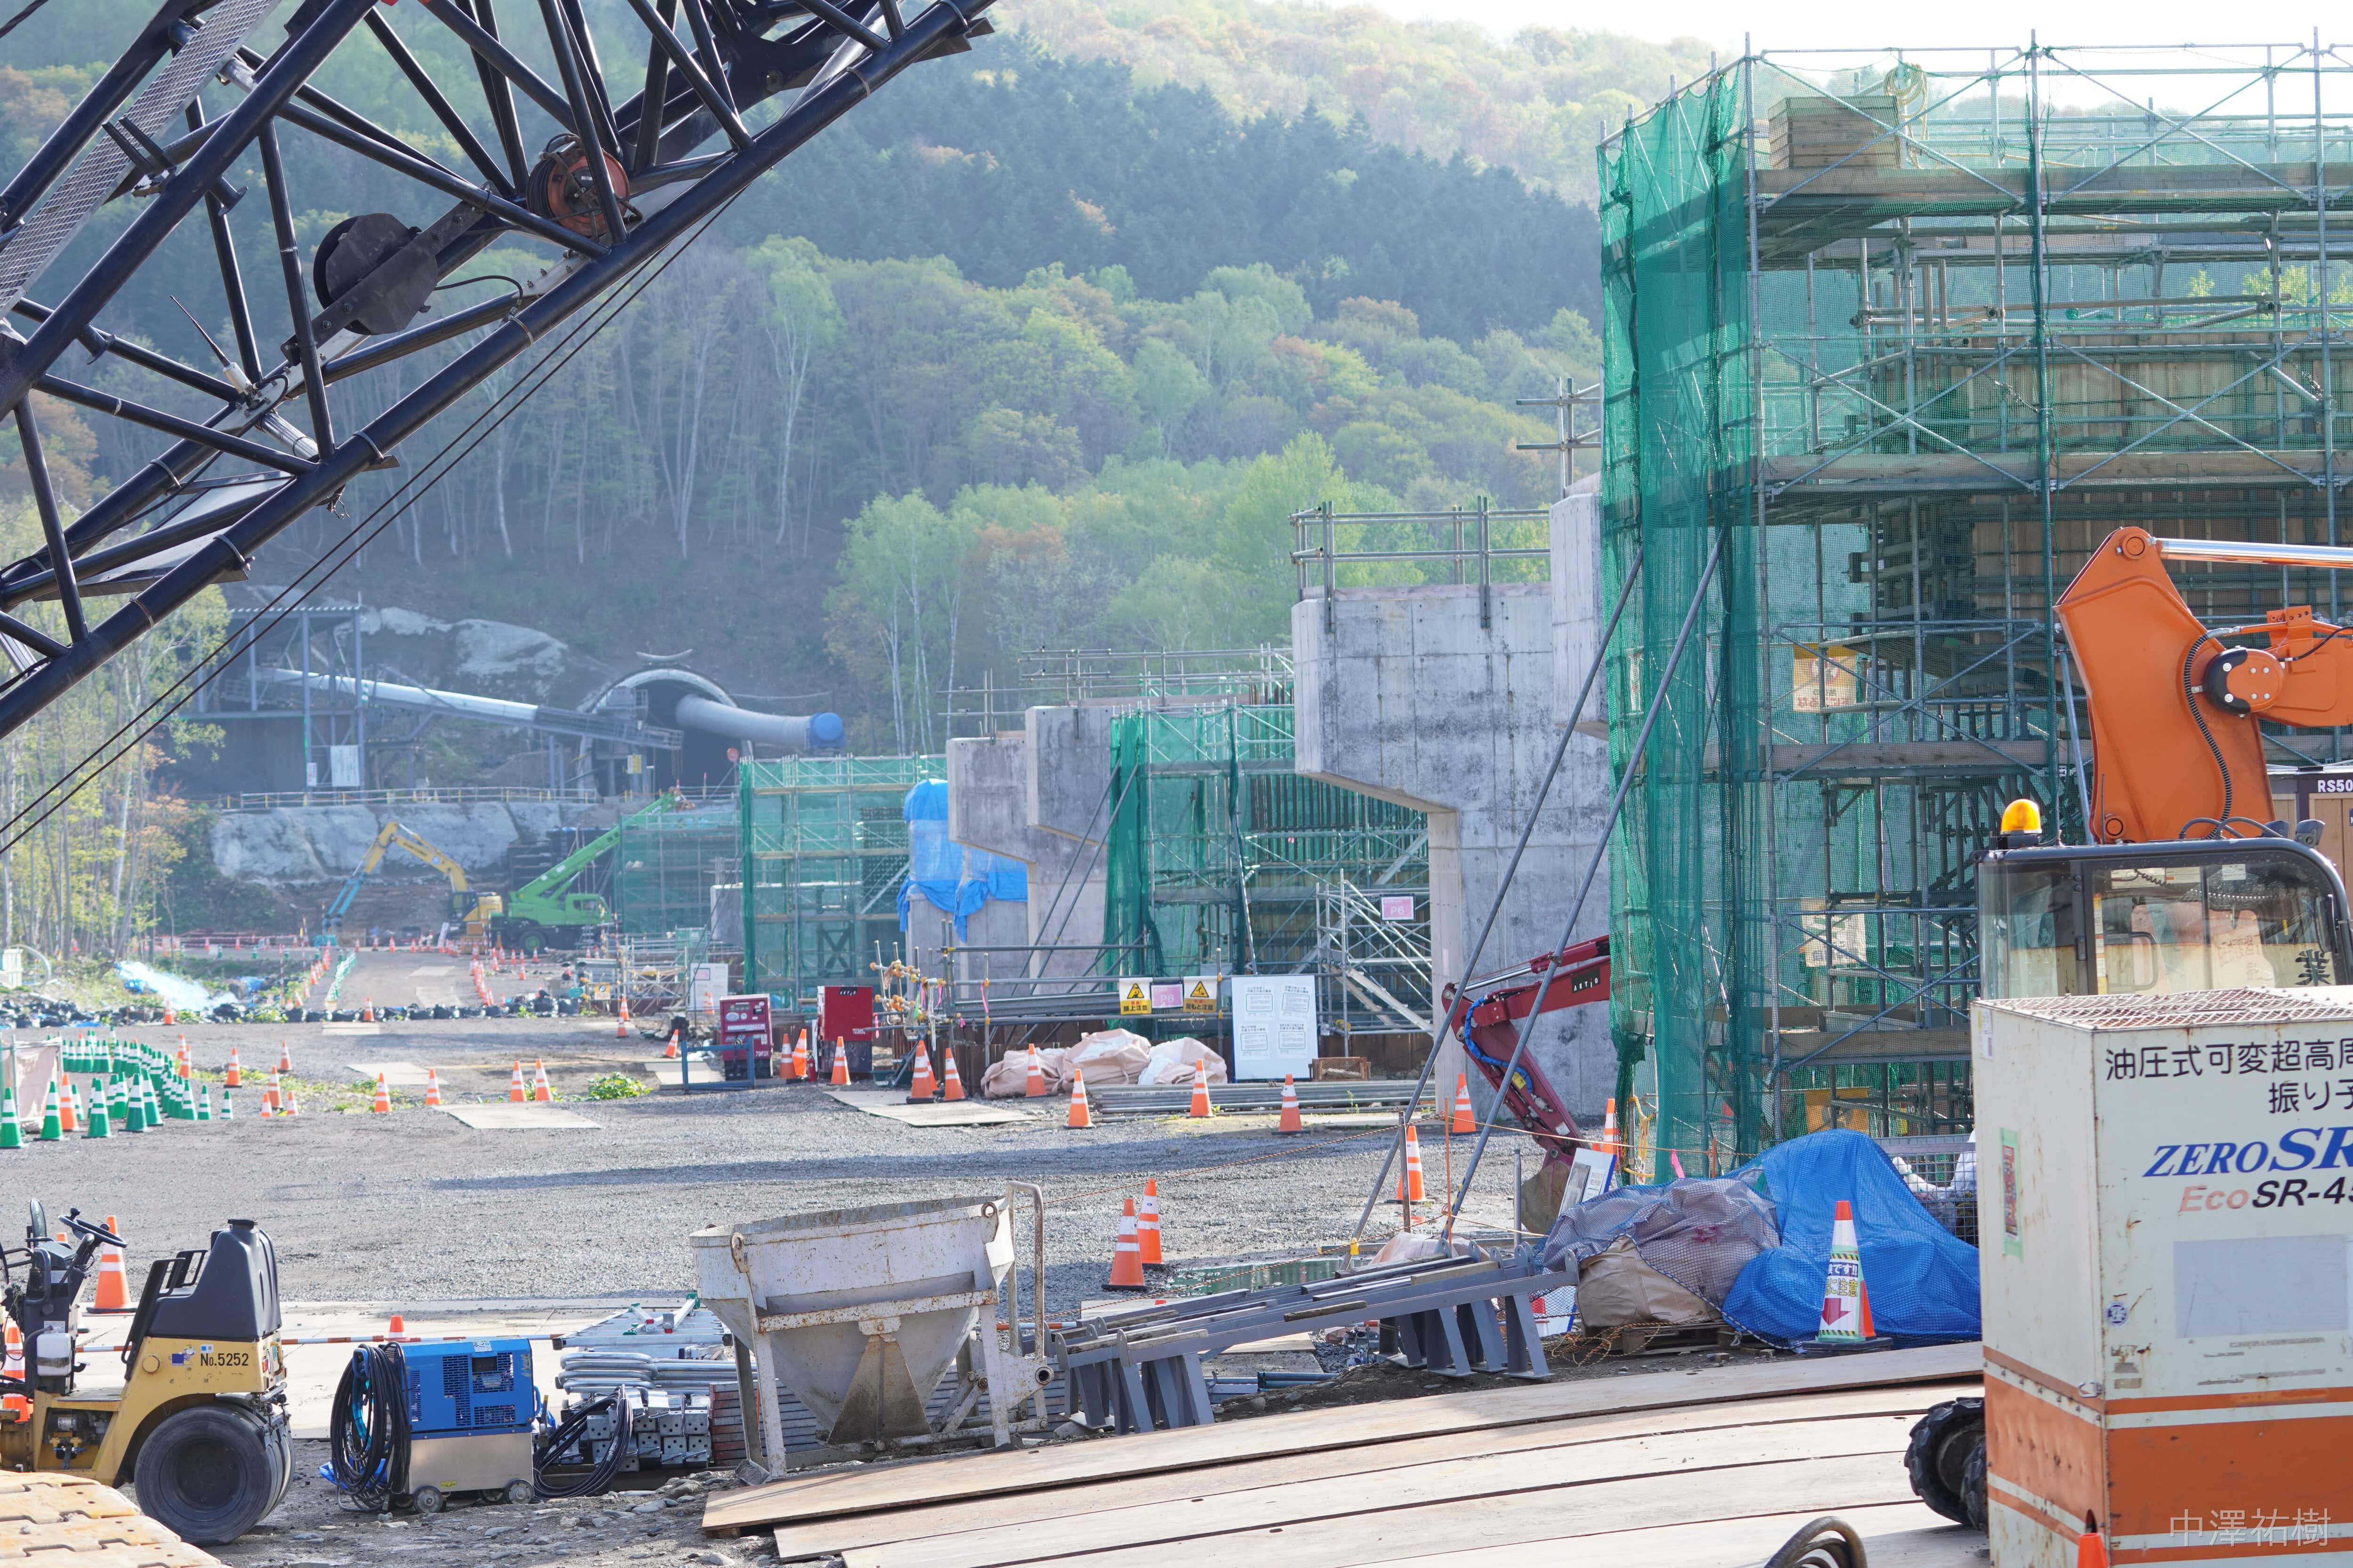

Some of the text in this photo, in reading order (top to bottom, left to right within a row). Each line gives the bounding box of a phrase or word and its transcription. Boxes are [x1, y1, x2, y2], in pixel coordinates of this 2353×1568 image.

[1390, 906, 1404, 915] P6
[1160, 994, 1174, 1002] P6
[201, 1353, 249, 1367] No.5252
